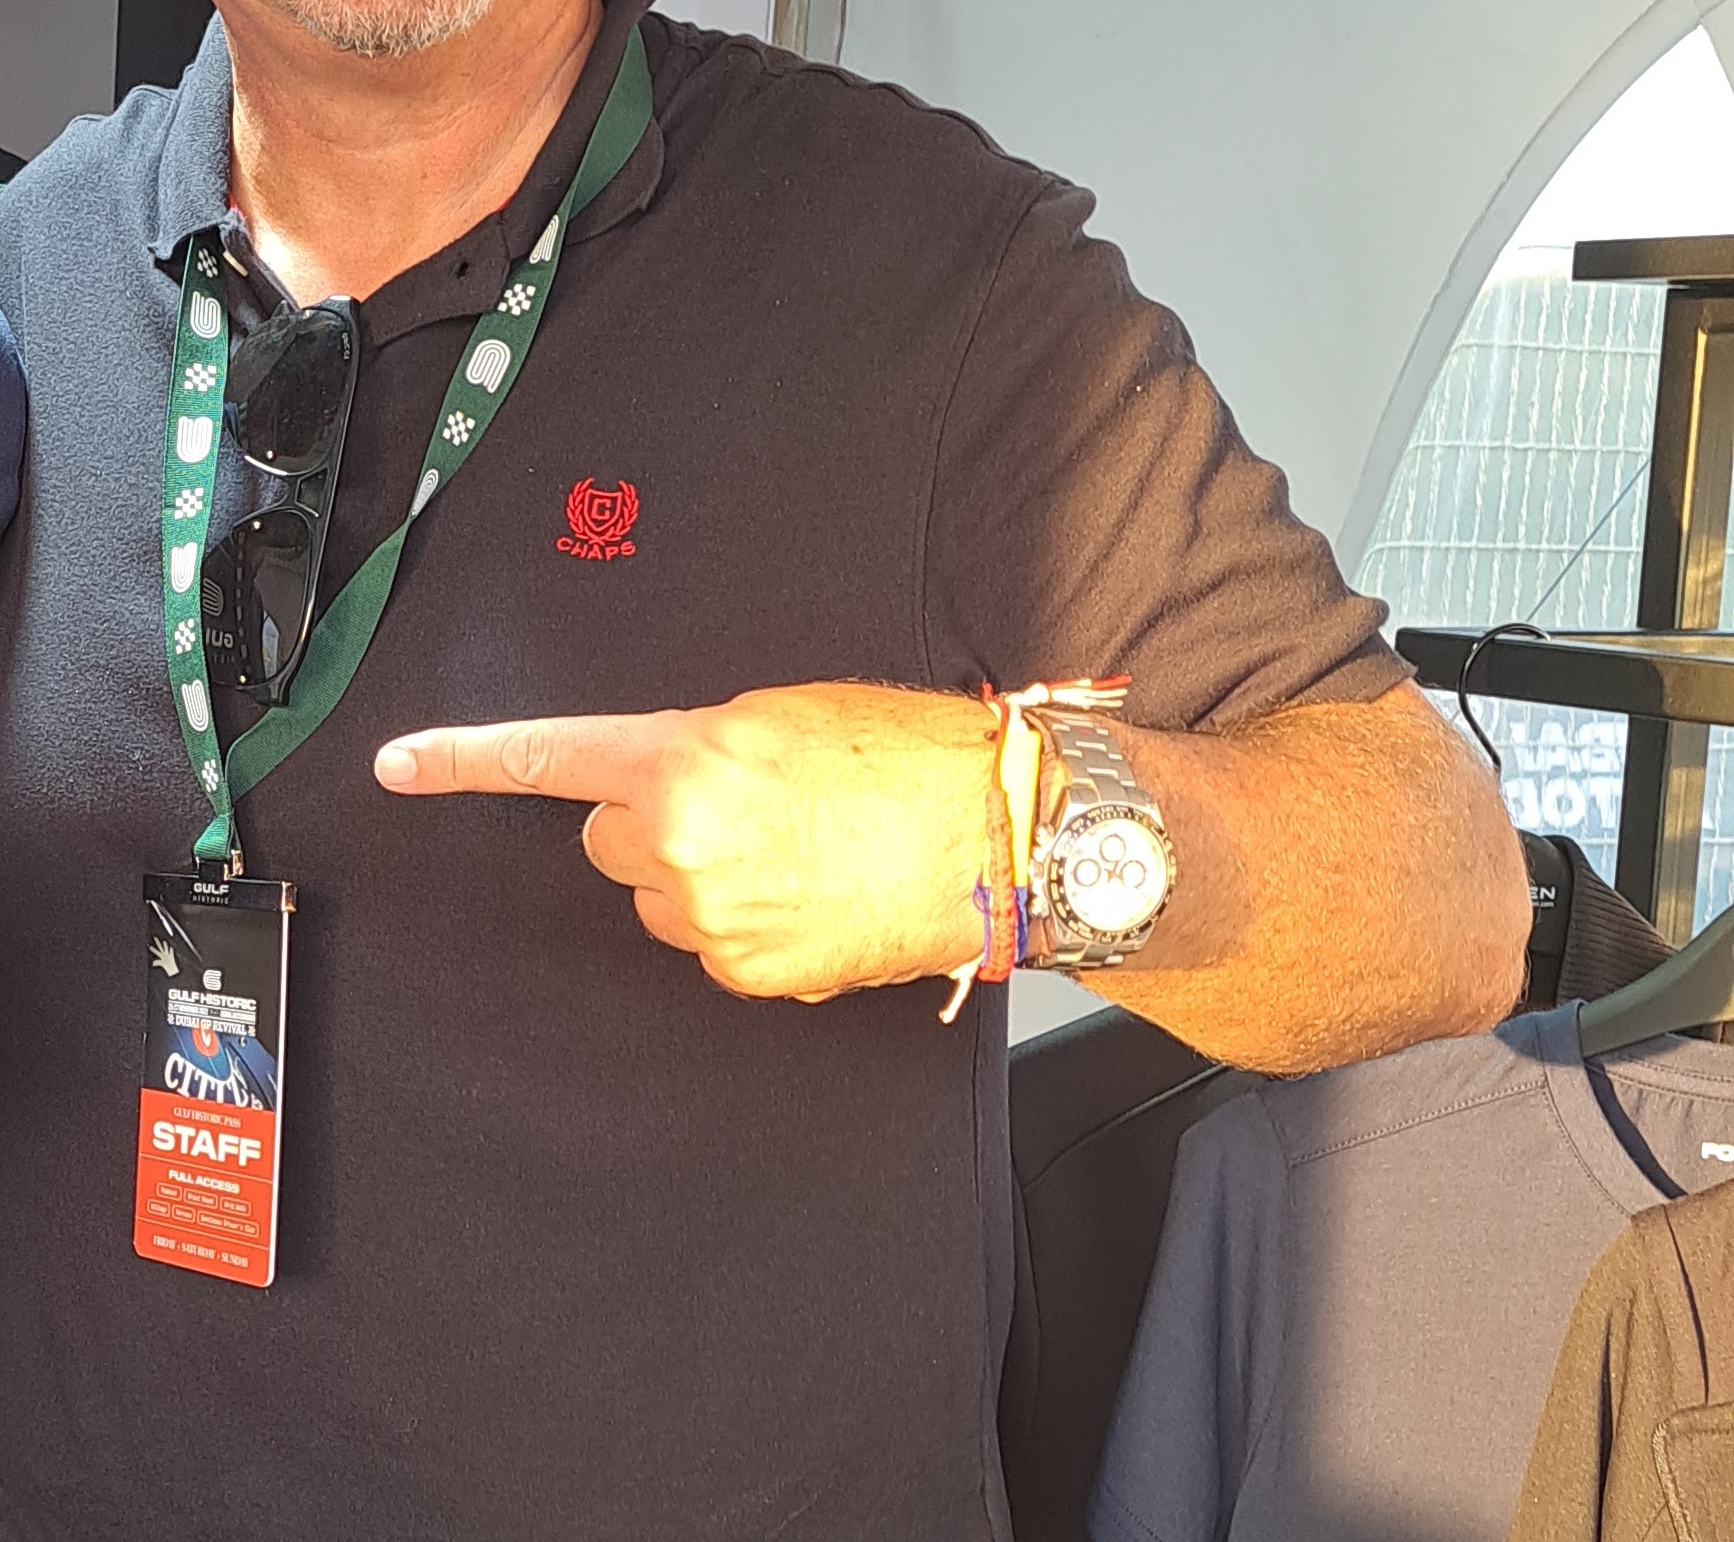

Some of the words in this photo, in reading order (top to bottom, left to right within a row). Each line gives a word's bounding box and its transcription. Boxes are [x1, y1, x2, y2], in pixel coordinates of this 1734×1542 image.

[556, 536, 637, 561] CHAPS
[193, 882, 230, 895] GULF
[168, 988, 200, 1004] GULF
[200, 991, 257, 1011] HISTORIC
[152, 1120, 262, 1168] STAFF
[168, 1169, 195, 1185] FULL
[195, 1175, 241, 1195] ACCESS
